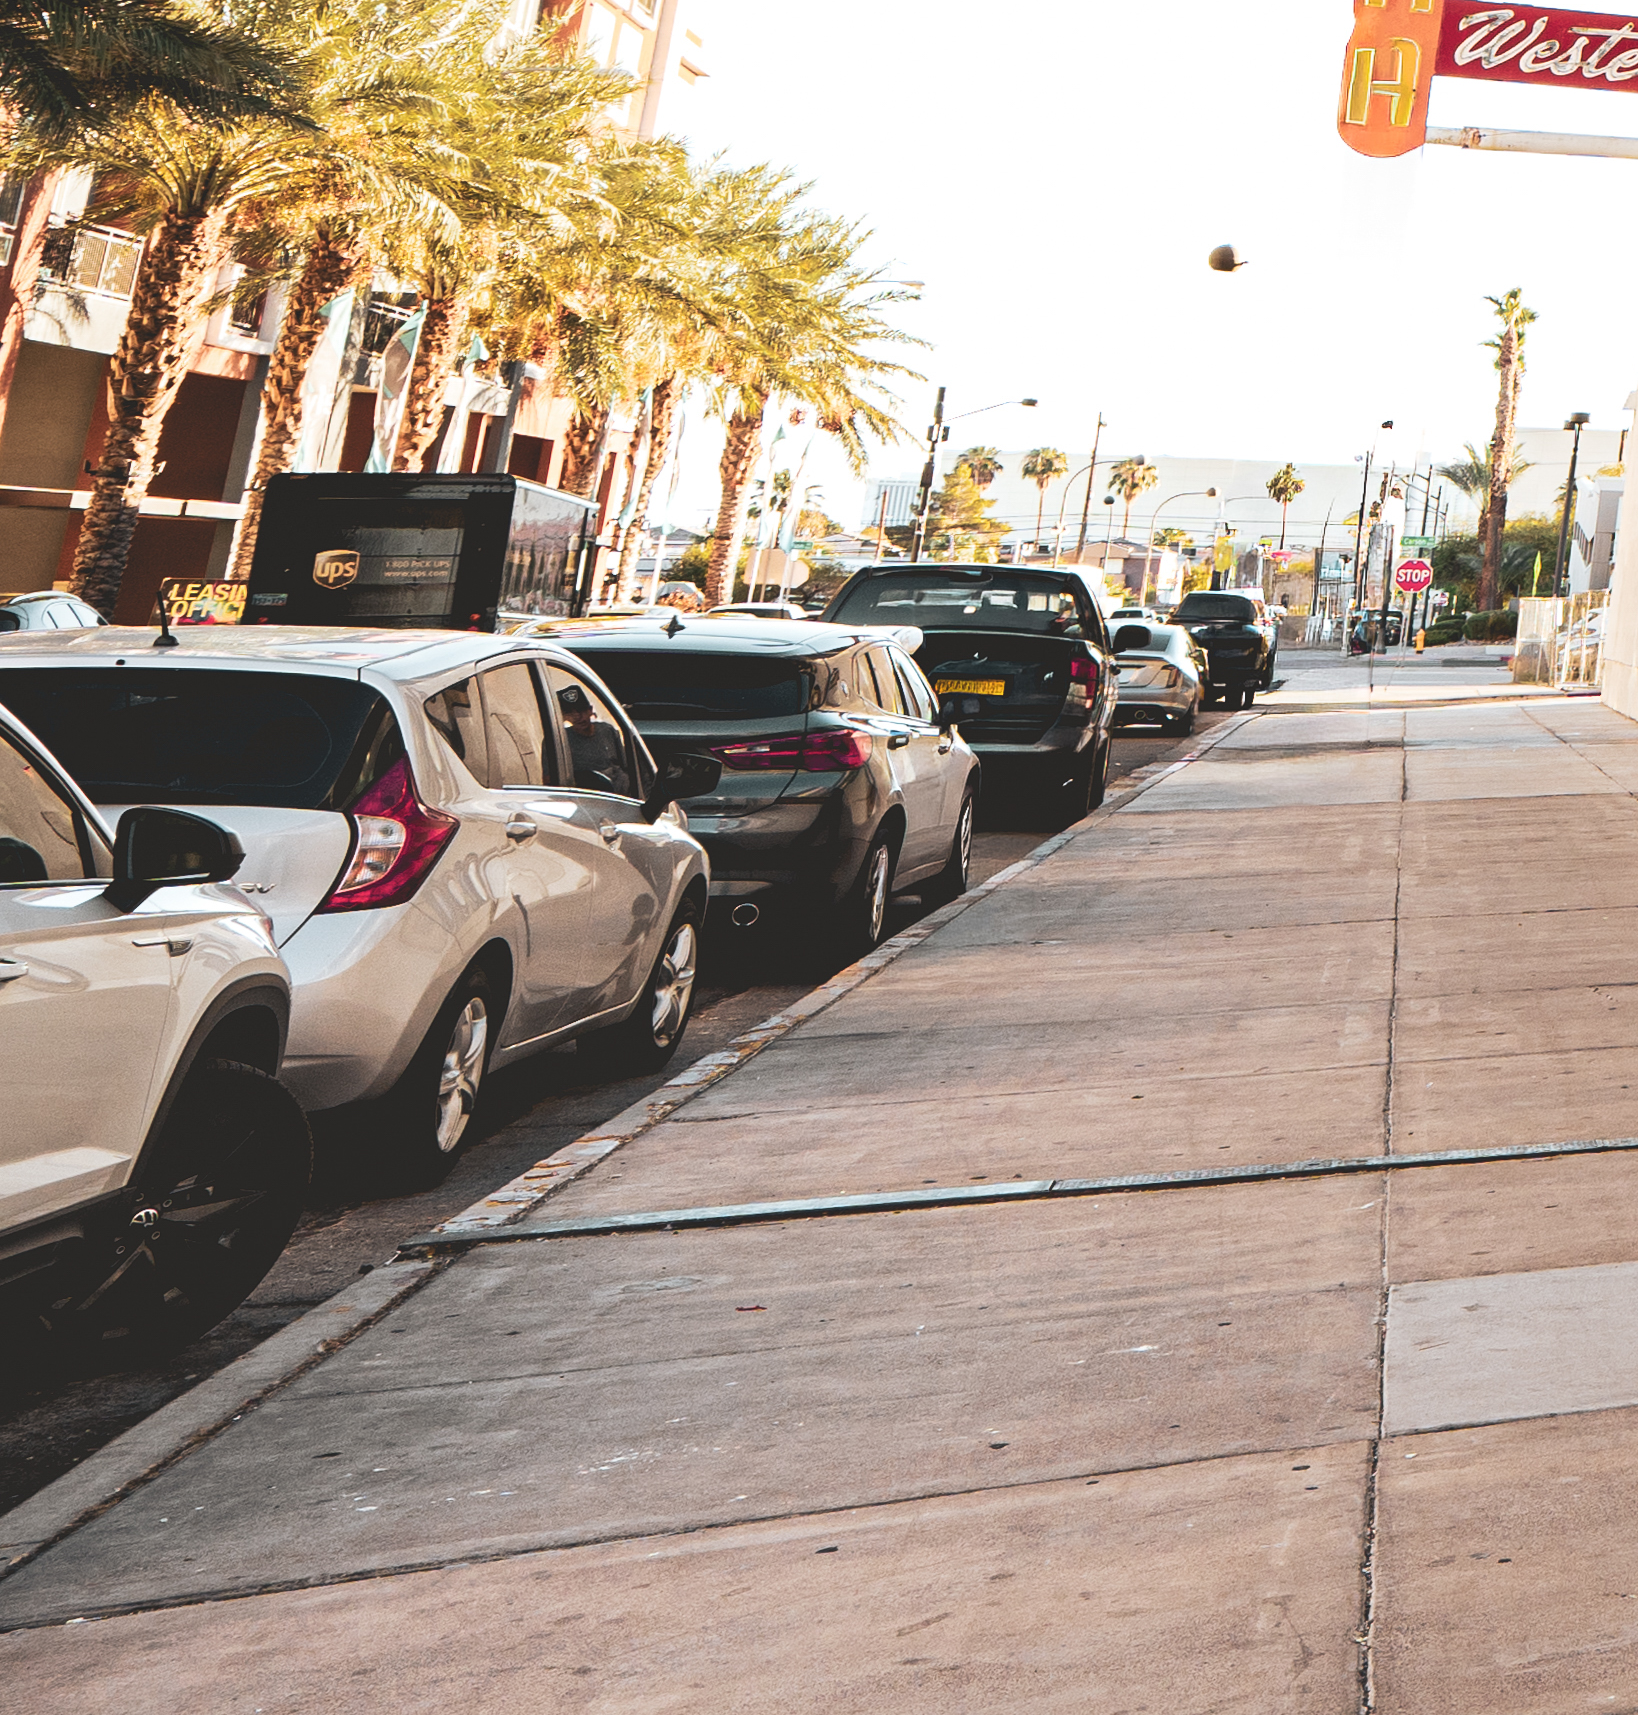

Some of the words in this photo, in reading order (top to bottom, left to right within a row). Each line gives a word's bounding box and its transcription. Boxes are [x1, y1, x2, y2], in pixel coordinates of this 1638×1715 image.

[1403, 537, 1427, 545] Carson
[433, 560, 451, 568] UPS
[315, 561, 356, 584] ups
[1396, 568, 1430, 583] STOP
